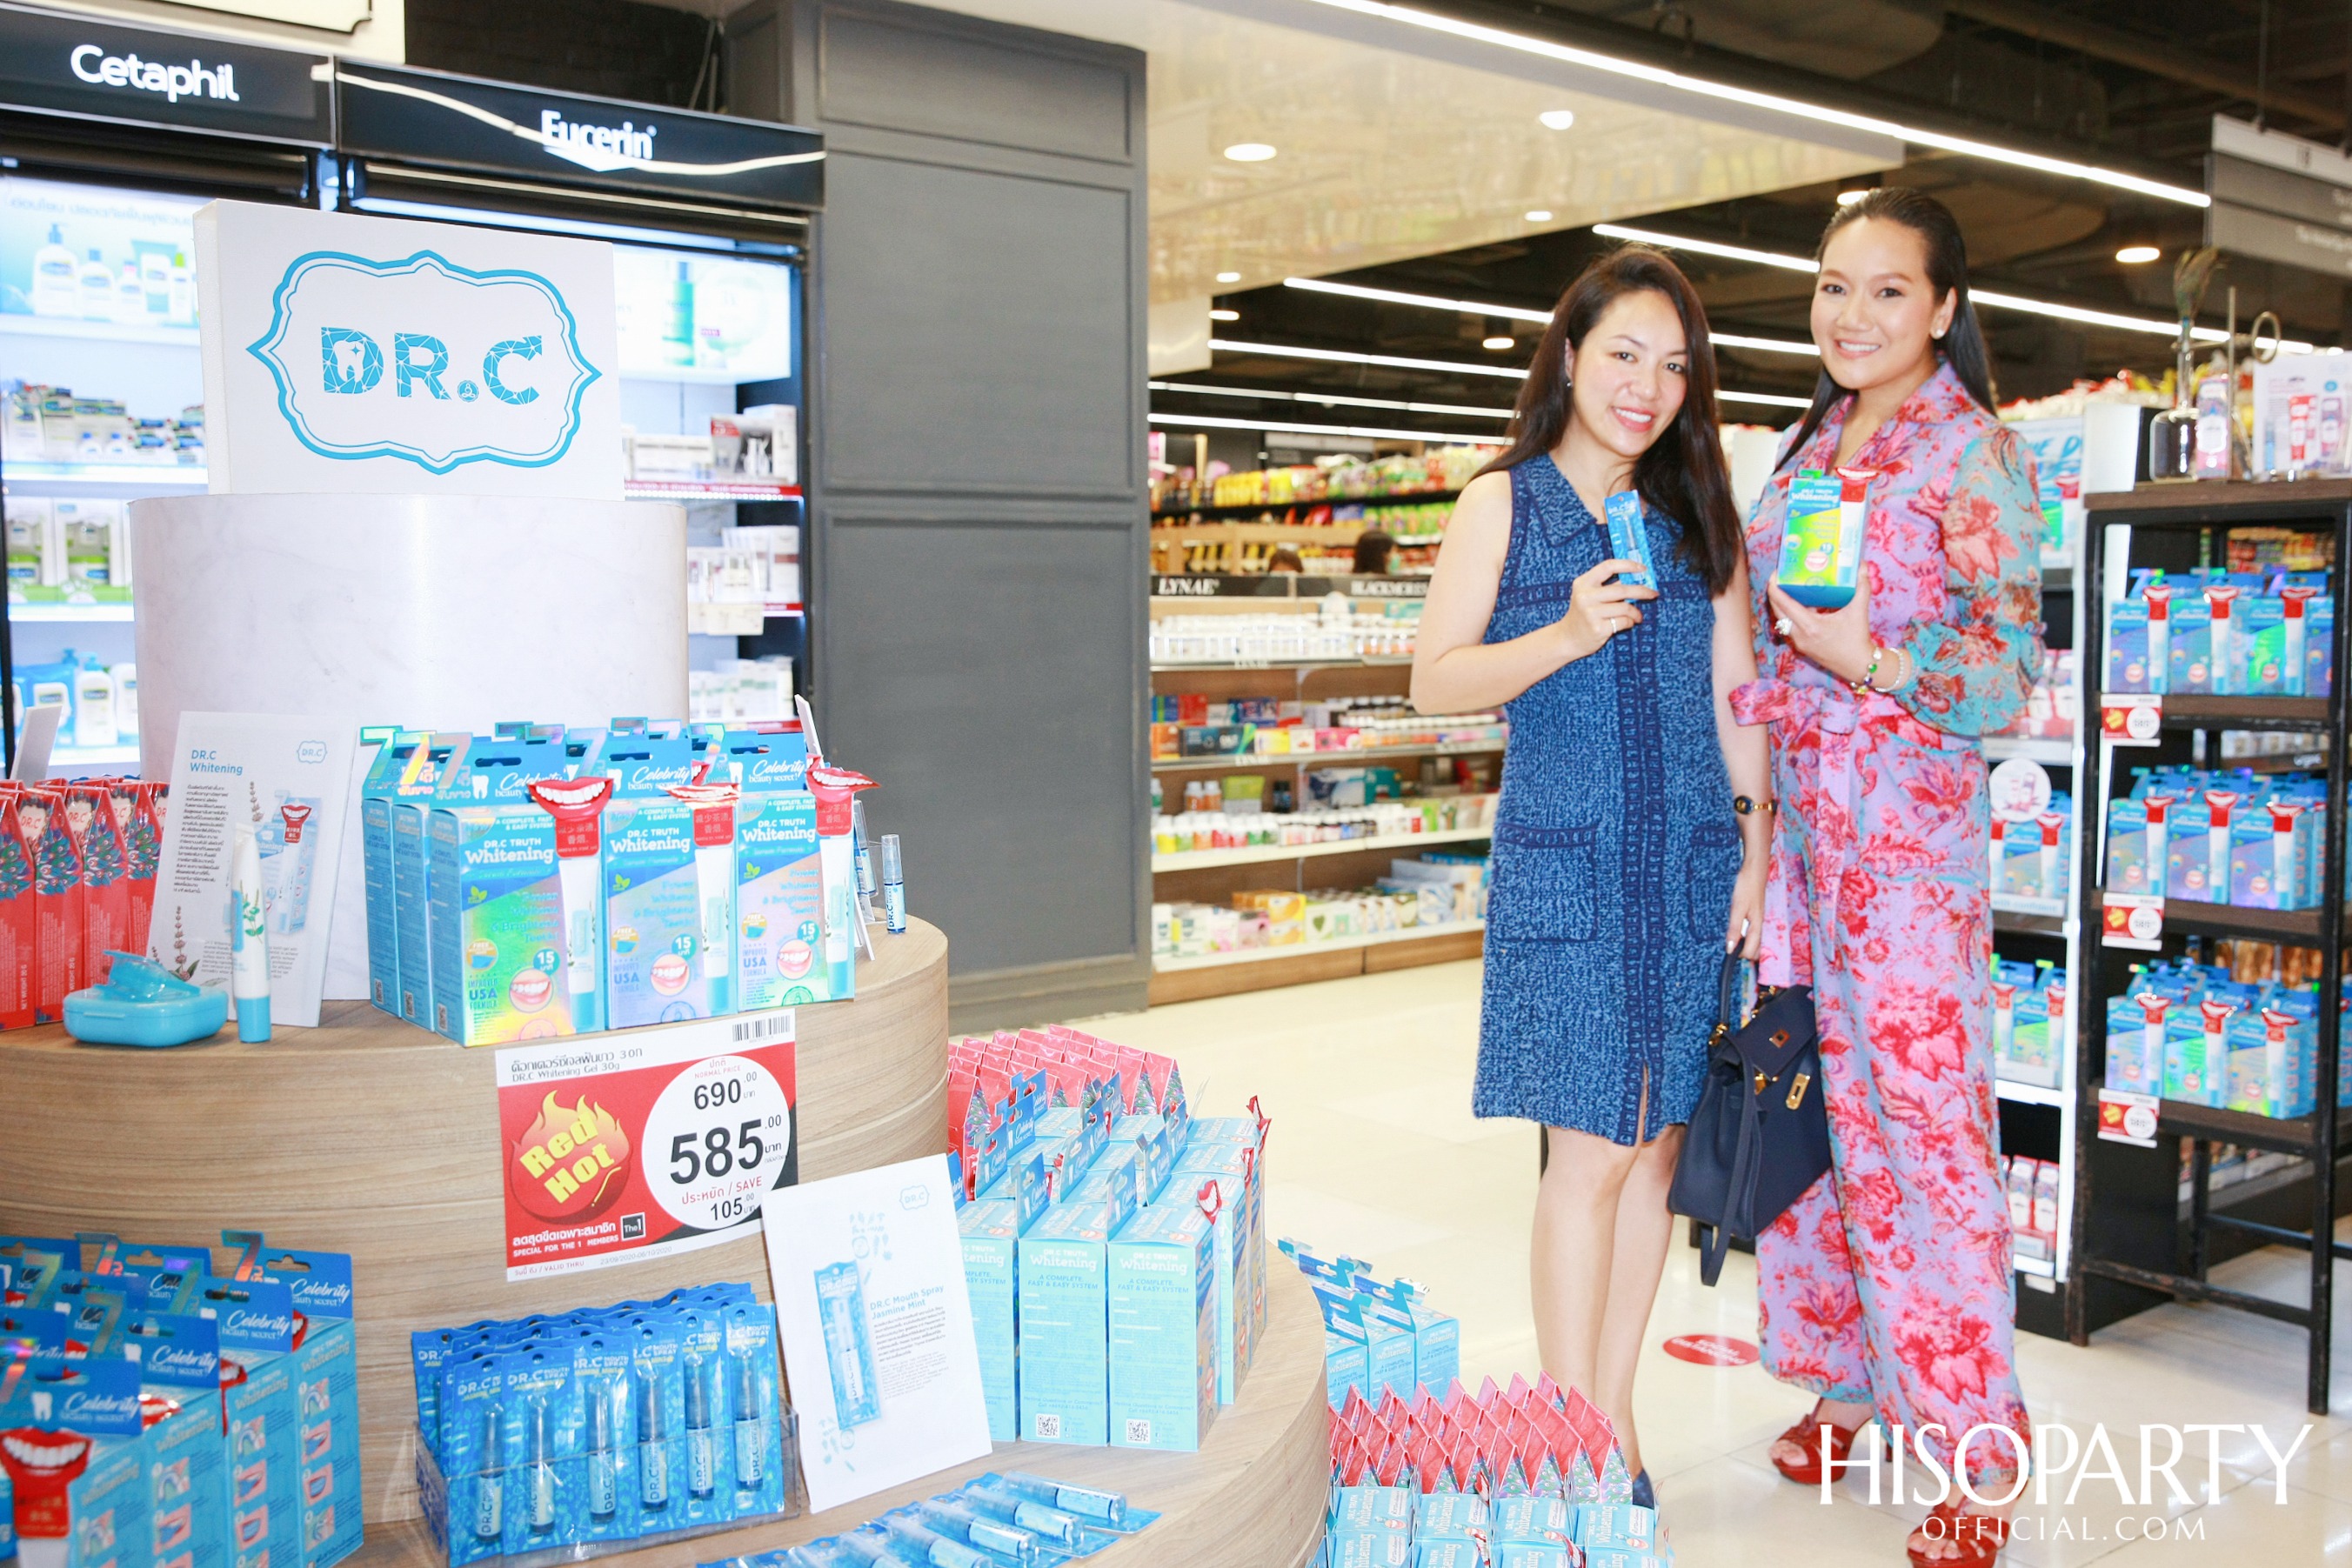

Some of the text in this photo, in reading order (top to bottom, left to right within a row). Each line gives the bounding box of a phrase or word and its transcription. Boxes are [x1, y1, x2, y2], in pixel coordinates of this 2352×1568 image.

[70, 44, 239, 103] Cetaphil
[541, 110, 653, 162] Eucerin
[320, 326, 543, 406] DR.C
[1158, 577, 1214, 595] LYNAE
[191, 750, 217, 760] DR.C
[190, 762, 243, 776] Whitening
[632, 766, 691, 784] Celebrity
[752, 759, 806, 777] Celebrity
[749, 772, 798, 784] beauty secret!
[628, 783, 652, 791] beauty
[21, 816, 41, 830] DR.C
[68, 811, 88, 823] DR.C
[758, 817, 805, 828] DR.C TRUTH
[627, 830, 648, 838] DR.C
[742, 827, 816, 843] Whitening
[484, 837, 541, 849] DR.C TRUTH
[610, 836, 691, 853] Whitening
[464, 846, 555, 864] Whitening
[885, 904, 895, 928] DR.C
[800, 923, 816, 935] 15
[675, 937, 692, 950] 15
[537, 951, 555, 965] 15
[743, 957, 767, 968] USA
[614, 972, 639, 984] USA
[469, 988, 498, 1001] USA
[512, 1062, 620, 1082] DR.C Whitening Gel 30g
[695, 1065, 741, 1079] NORMAL PRICE
[694, 1078, 741, 1110] 690
[520, 1112, 598, 1179] Red
[671, 1118, 764, 1184] 585
[765, 1142, 781, 1154] บาท
[544, 1143, 614, 1204] Hot
[736, 1176, 762, 1192] SAVE
[904, 1191, 925, 1204] DR.C
[710, 1198, 743, 1221] 105
[513, 1245, 542, 1258] SPECIAL
[545, 1243, 558, 1252] FOR
[587, 1235, 618, 1246] MEMBERS
[545, 1263, 565, 1272] VALID
[566, 1260, 585, 1269] THRU
[1030, 1255, 1097, 1271] Whitening
[1119, 1258, 1187, 1276] Whitening
[291, 1278, 351, 1304] Celebrity
[871, 1285, 944, 1311] DR.C Mouth Spray
[314, 1297, 342, 1306] secret!
[872, 1299, 925, 1320] Jasmine Mint
[227, 1310, 291, 1337] Celebrity
[222, 1326, 249, 1339] beauty
[1422, 1331, 1456, 1346] Whitening
[152, 1345, 217, 1374] Celebrity
[301, 1341, 350, 1372] Whitening
[1376, 1346, 1412, 1361] Whitening
[1328, 1358, 1365, 1374] Whitening
[507, 1370, 543, 1385] DR.C
[458, 1377, 491, 1396] DR.C
[65, 1391, 140, 1420] Celebrity
[649, 1468, 659, 1499] DR.C
[605, 1479, 613, 1511] DR.C
[1349, 1494, 1359, 1508] TRUTH
[529, 1493, 538, 1522] DR.C
[1355, 1489, 1380, 1528] Whitening
[1428, 1502, 1438, 1515] TRUTH
[1435, 1495, 1460, 1535] Whitening
[1507, 1505, 1517, 1520] TRUTH
[482, 1501, 492, 1533] DR.C
[1513, 1499, 1539, 1538] Whitening
[1595, 1505, 1618, 1544] Whitening
[1345, 1539, 1355, 1553] TRUTH
